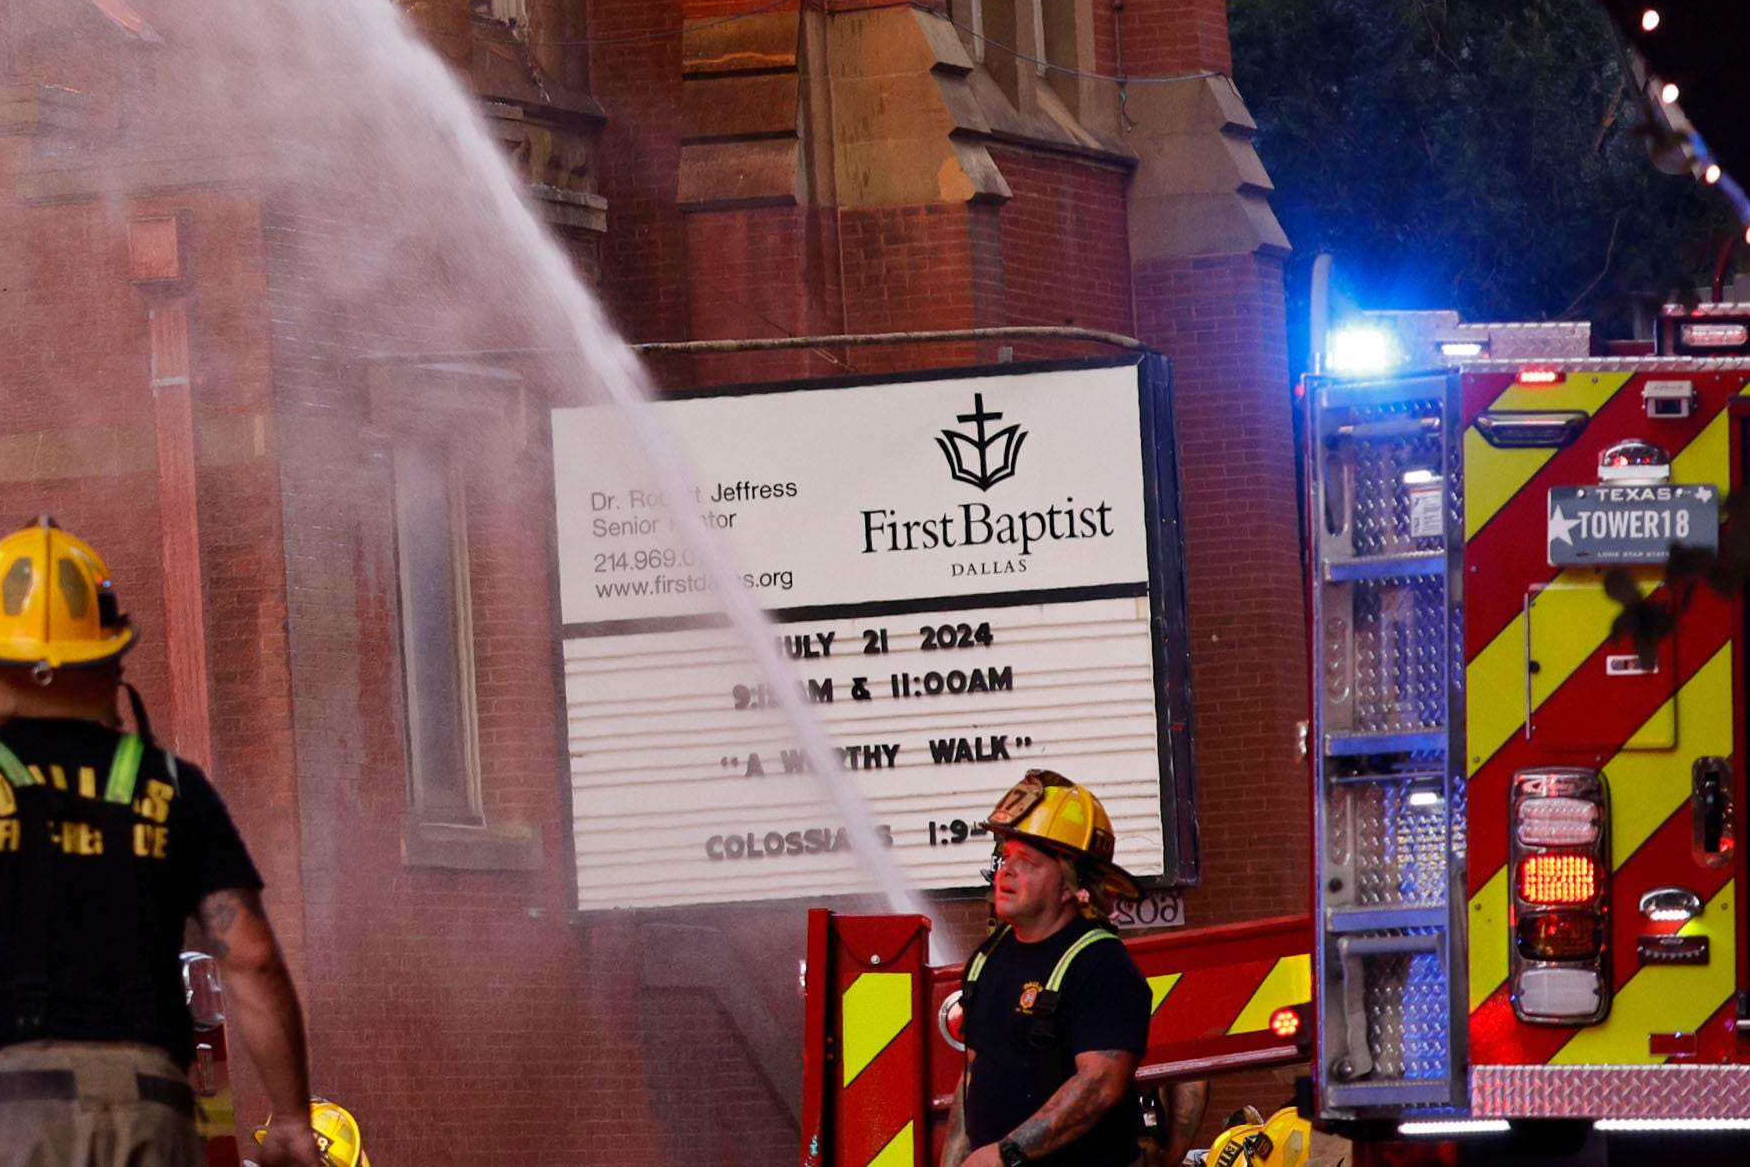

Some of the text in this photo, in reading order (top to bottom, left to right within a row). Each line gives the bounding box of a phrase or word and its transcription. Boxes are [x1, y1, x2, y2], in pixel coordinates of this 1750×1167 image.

[591, 491, 621, 512] Dr.
[711, 481, 798, 503] Jeffress
[1595, 487, 1672, 502] TEXAS
[592, 516, 659, 538] Senior
[1577, 509, 1690, 540] TOWER18
[951, 558, 1028, 577] DALLAS
[862, 628, 889, 655] 21
[919, 622, 994, 651] 2024
[851, 677, 873, 701] &
[891, 666, 1013, 698] 11:00AM
[705, 824, 894, 861] COLOSSIAS
